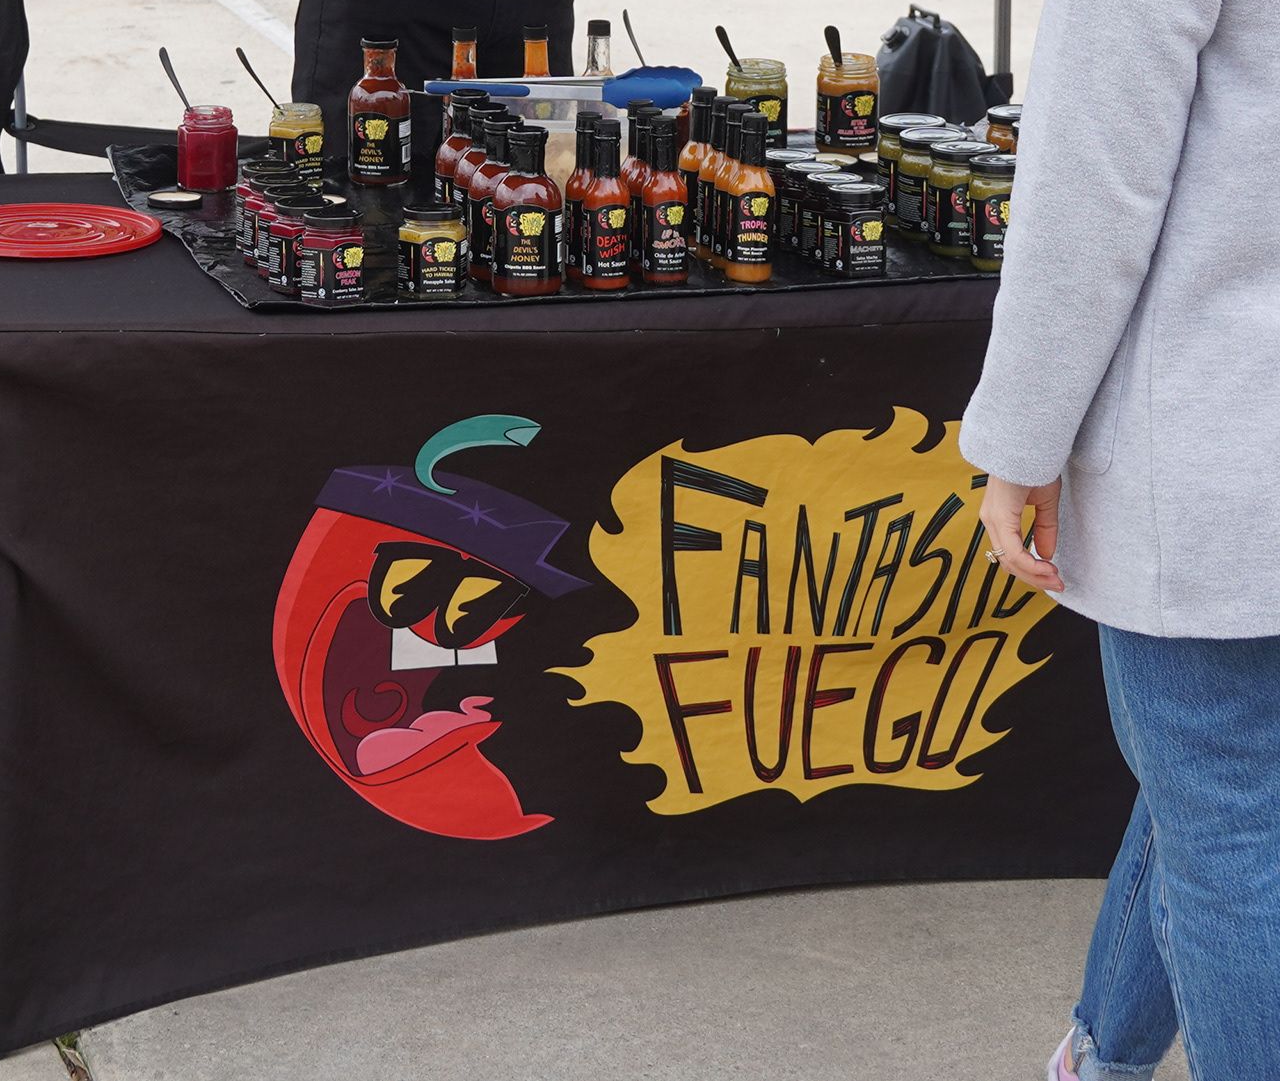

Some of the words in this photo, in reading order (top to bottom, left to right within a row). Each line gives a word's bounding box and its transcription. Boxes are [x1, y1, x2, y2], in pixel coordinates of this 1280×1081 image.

[740, 220, 768, 230] TROPIC
[596, 234, 627, 248] DEATH
[737, 232, 768, 244] THUNDER
[600, 243, 625, 258] WISH
[653, 630, 1009, 794] FUEGO
